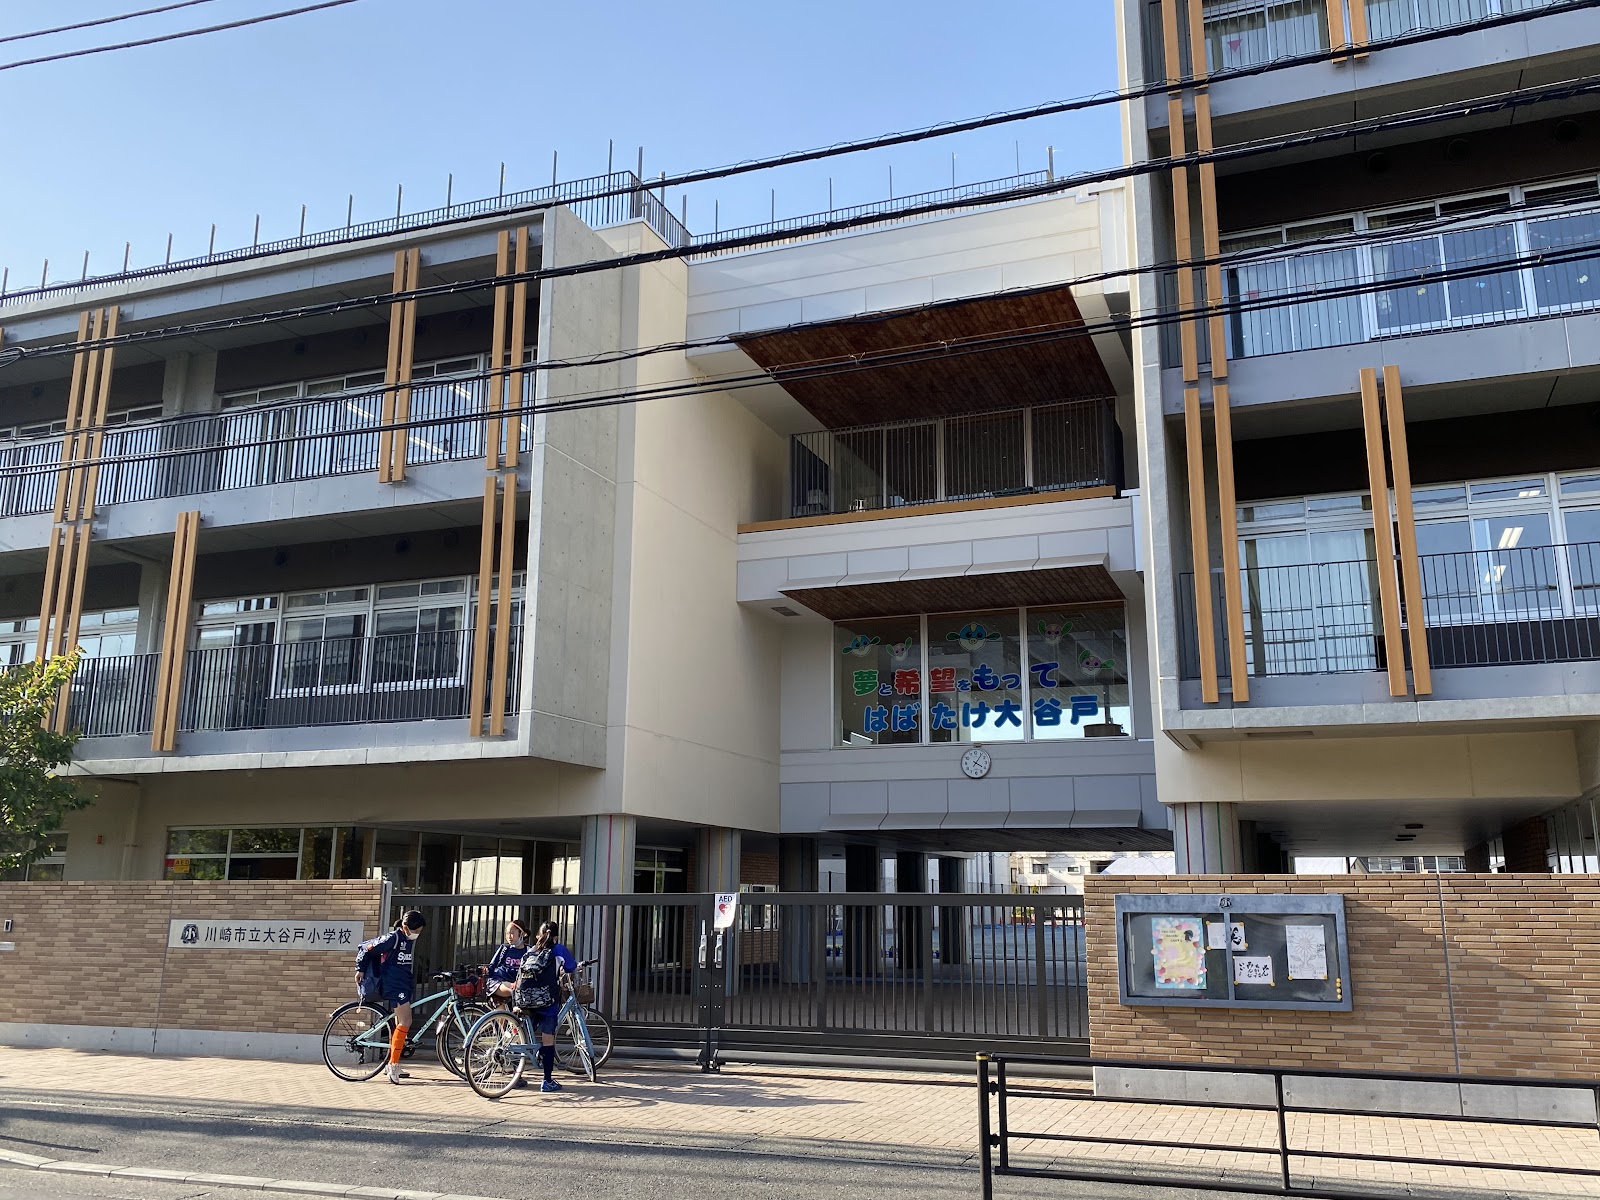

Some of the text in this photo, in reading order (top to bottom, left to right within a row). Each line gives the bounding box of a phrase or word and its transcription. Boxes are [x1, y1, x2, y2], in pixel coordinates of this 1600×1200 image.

[853, 661, 1060, 696] 夢と希望をもって
[864, 695, 1099, 733] はばたけ大谷戸
[204, 927, 352, 944] 川崎市立大谷戸小学校
